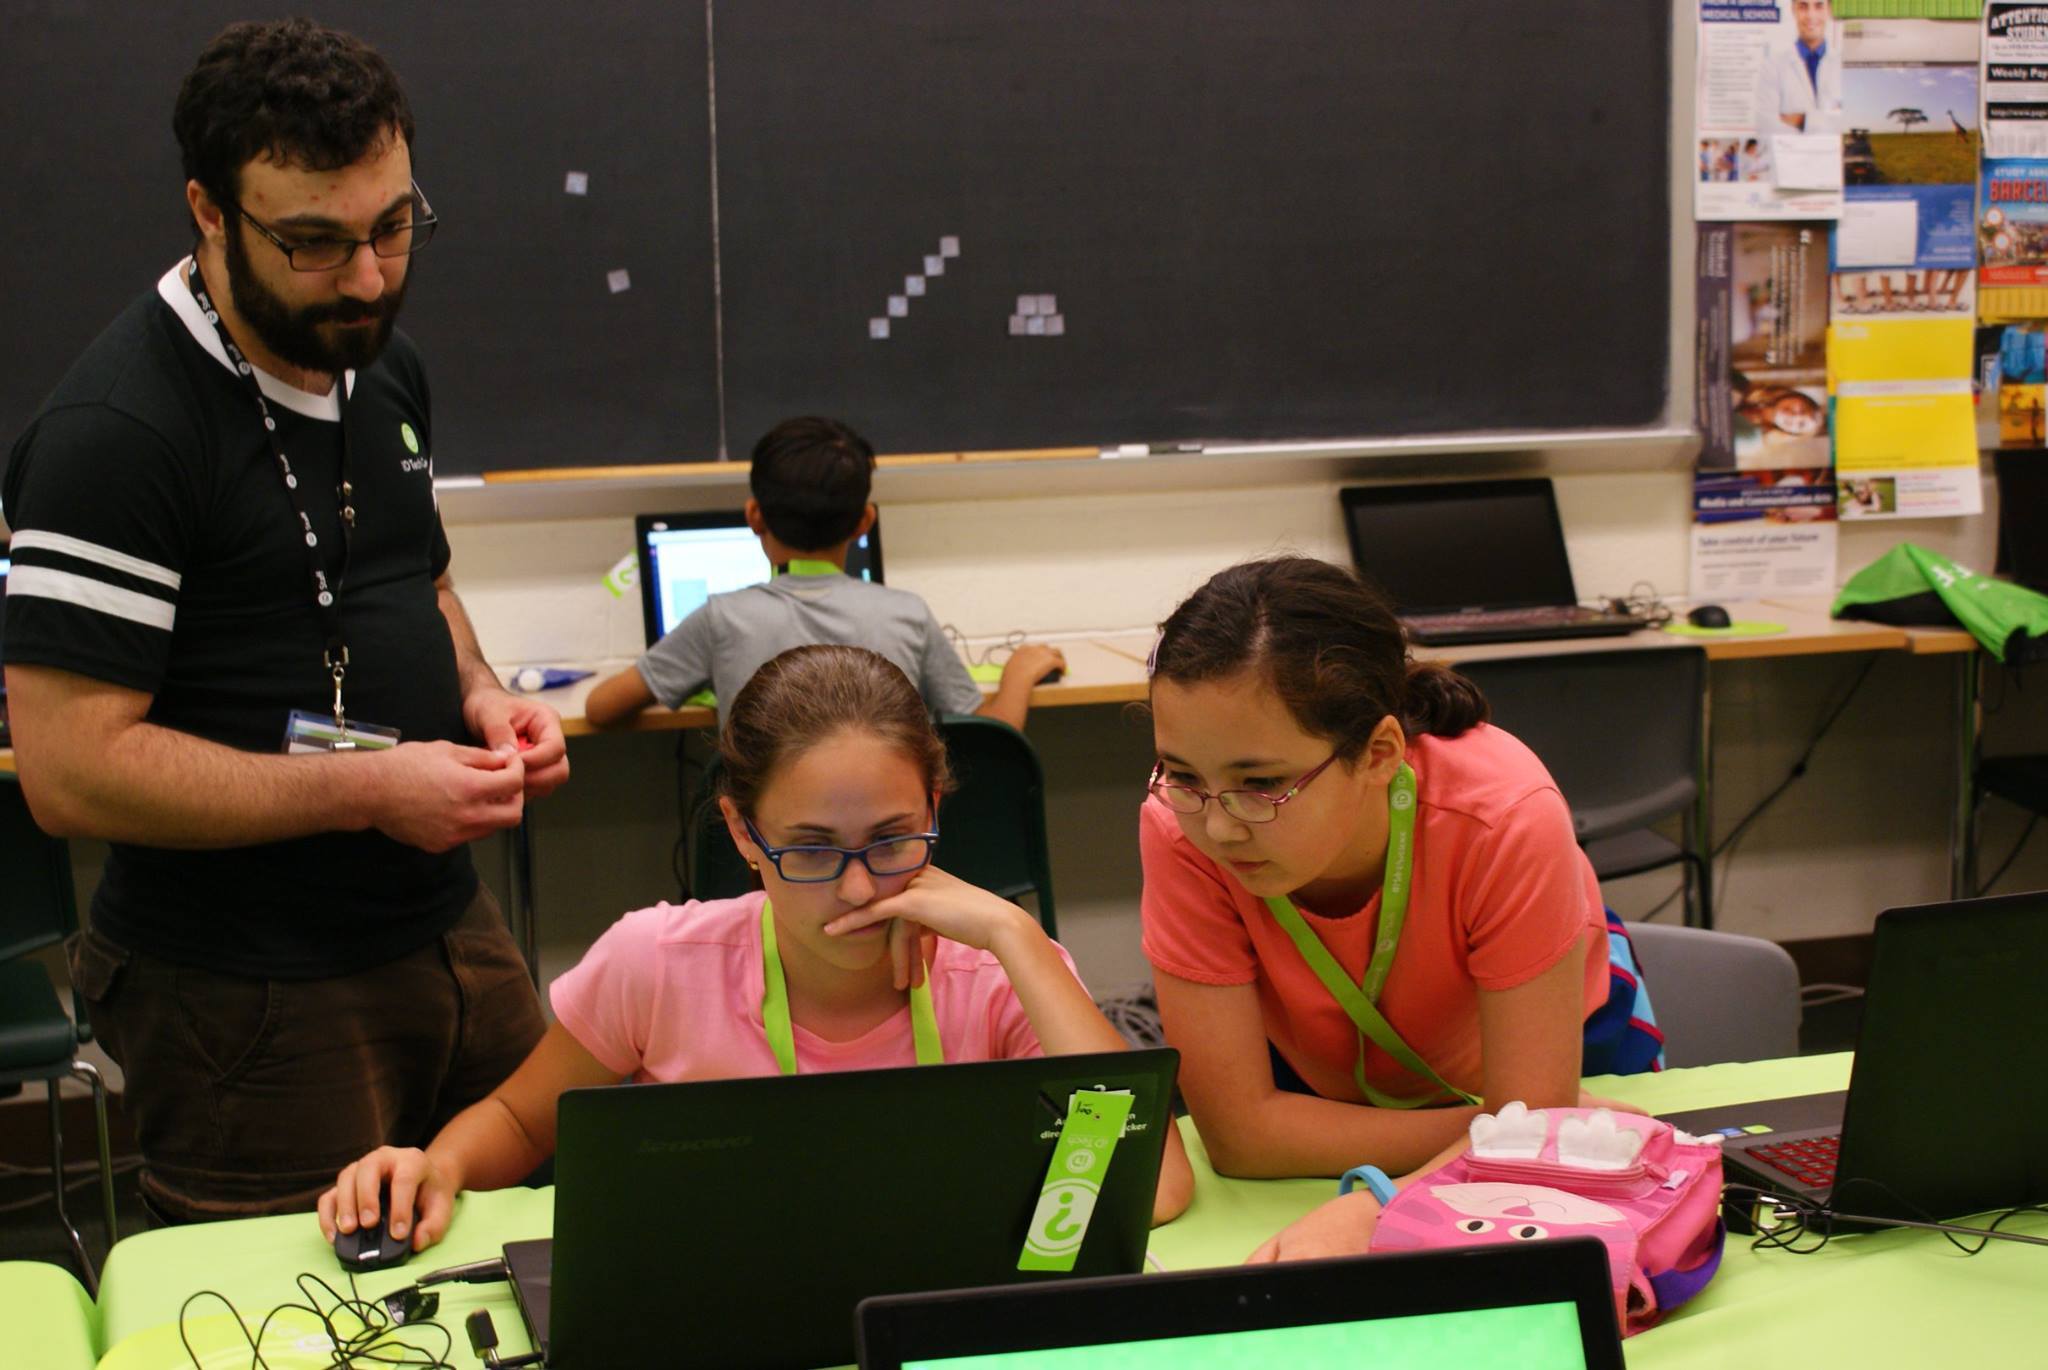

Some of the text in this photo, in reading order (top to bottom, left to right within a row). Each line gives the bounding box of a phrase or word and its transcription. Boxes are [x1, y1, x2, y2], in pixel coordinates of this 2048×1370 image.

[1701, 8, 1777, 19] MEDICAL SCHOOL
[1991, 66, 2028, 81] Weekly
[1699, 497, 1727, 508] Media
[1728, 497, 1745, 507] and
